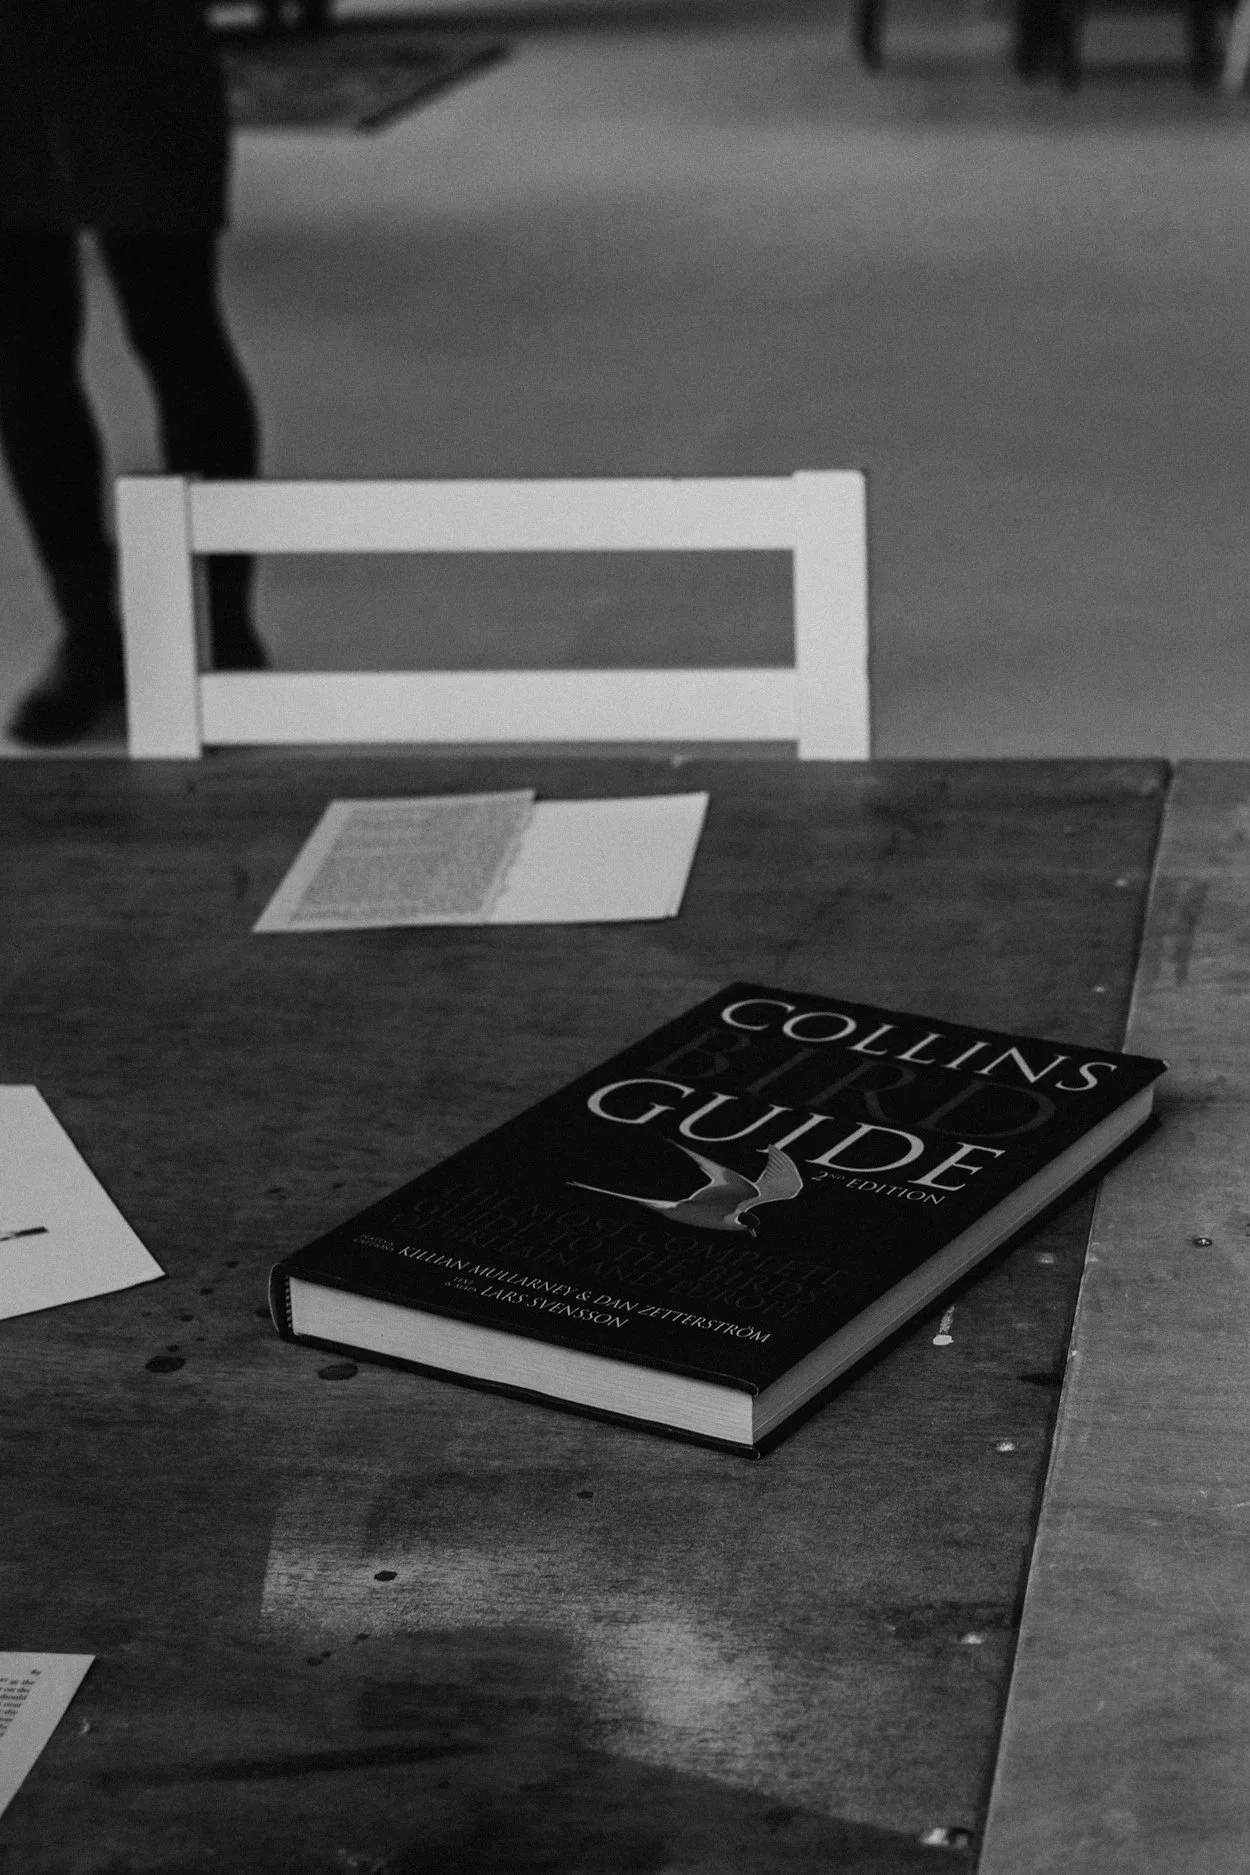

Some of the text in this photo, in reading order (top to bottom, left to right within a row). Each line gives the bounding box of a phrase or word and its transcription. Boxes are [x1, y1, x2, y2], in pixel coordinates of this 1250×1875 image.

[643, 1027, 1058, 1138] BIRD
[721, 998, 1117, 1093] COLLINS
[586, 1078, 1006, 1193] GUIDE
[846, 1178, 945, 1205] EDITION
[397, 1245, 772, 1344] KILLIAN MULLARNEY & DAN ZETTERSTRÖM
[413, 1199, 818, 1304] GUIDE TO THE BIRDS
[579, 1261, 664, 1287] AND
[669, 1278, 804, 1320] EUROPE
[637, 1230, 850, 1286] COMPLETE
[480, 1285, 630, 1329] LARS SVENSSON
